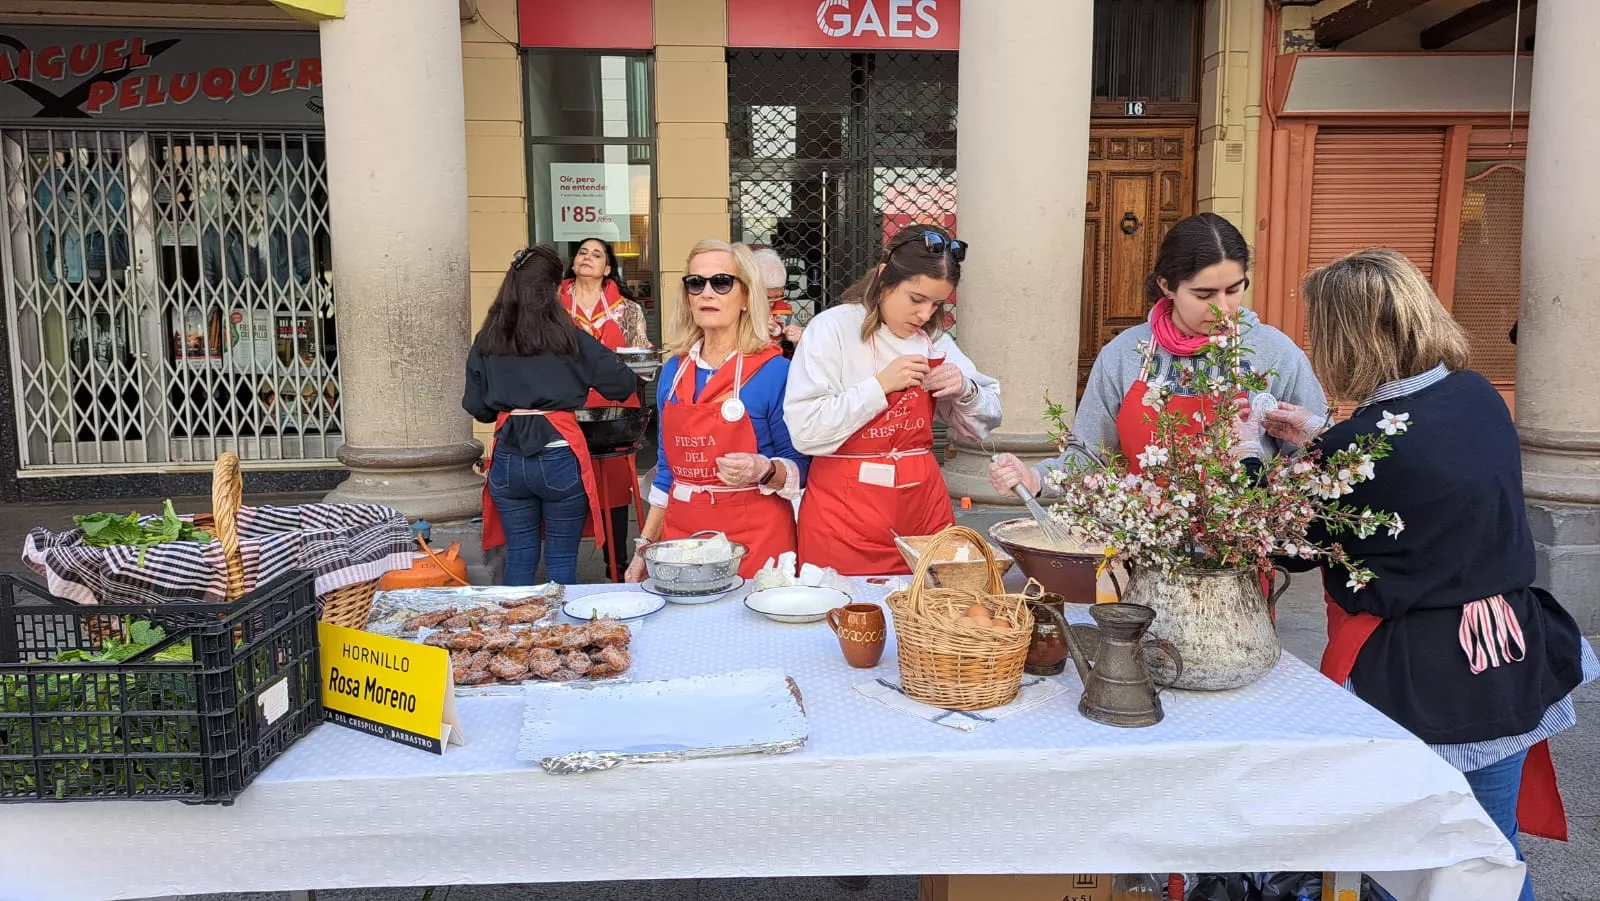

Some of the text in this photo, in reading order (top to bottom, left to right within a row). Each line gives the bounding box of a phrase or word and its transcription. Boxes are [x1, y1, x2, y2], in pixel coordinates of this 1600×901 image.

[816, 0, 939, 38] GAES
[1128, 102, 1143, 115] 16
[576, 176, 596, 184] pero
[674, 435, 717, 447] FIESTA
[685, 451, 708, 463] DEL
[342, 643, 410, 673] HORNILLO
[328, 666, 417, 713] Rosa Moreno
[335, 713, 348, 723] DEL
[348, 717, 384, 735] CRESPILLO
[391, 729, 433, 749] BARBASTRO
